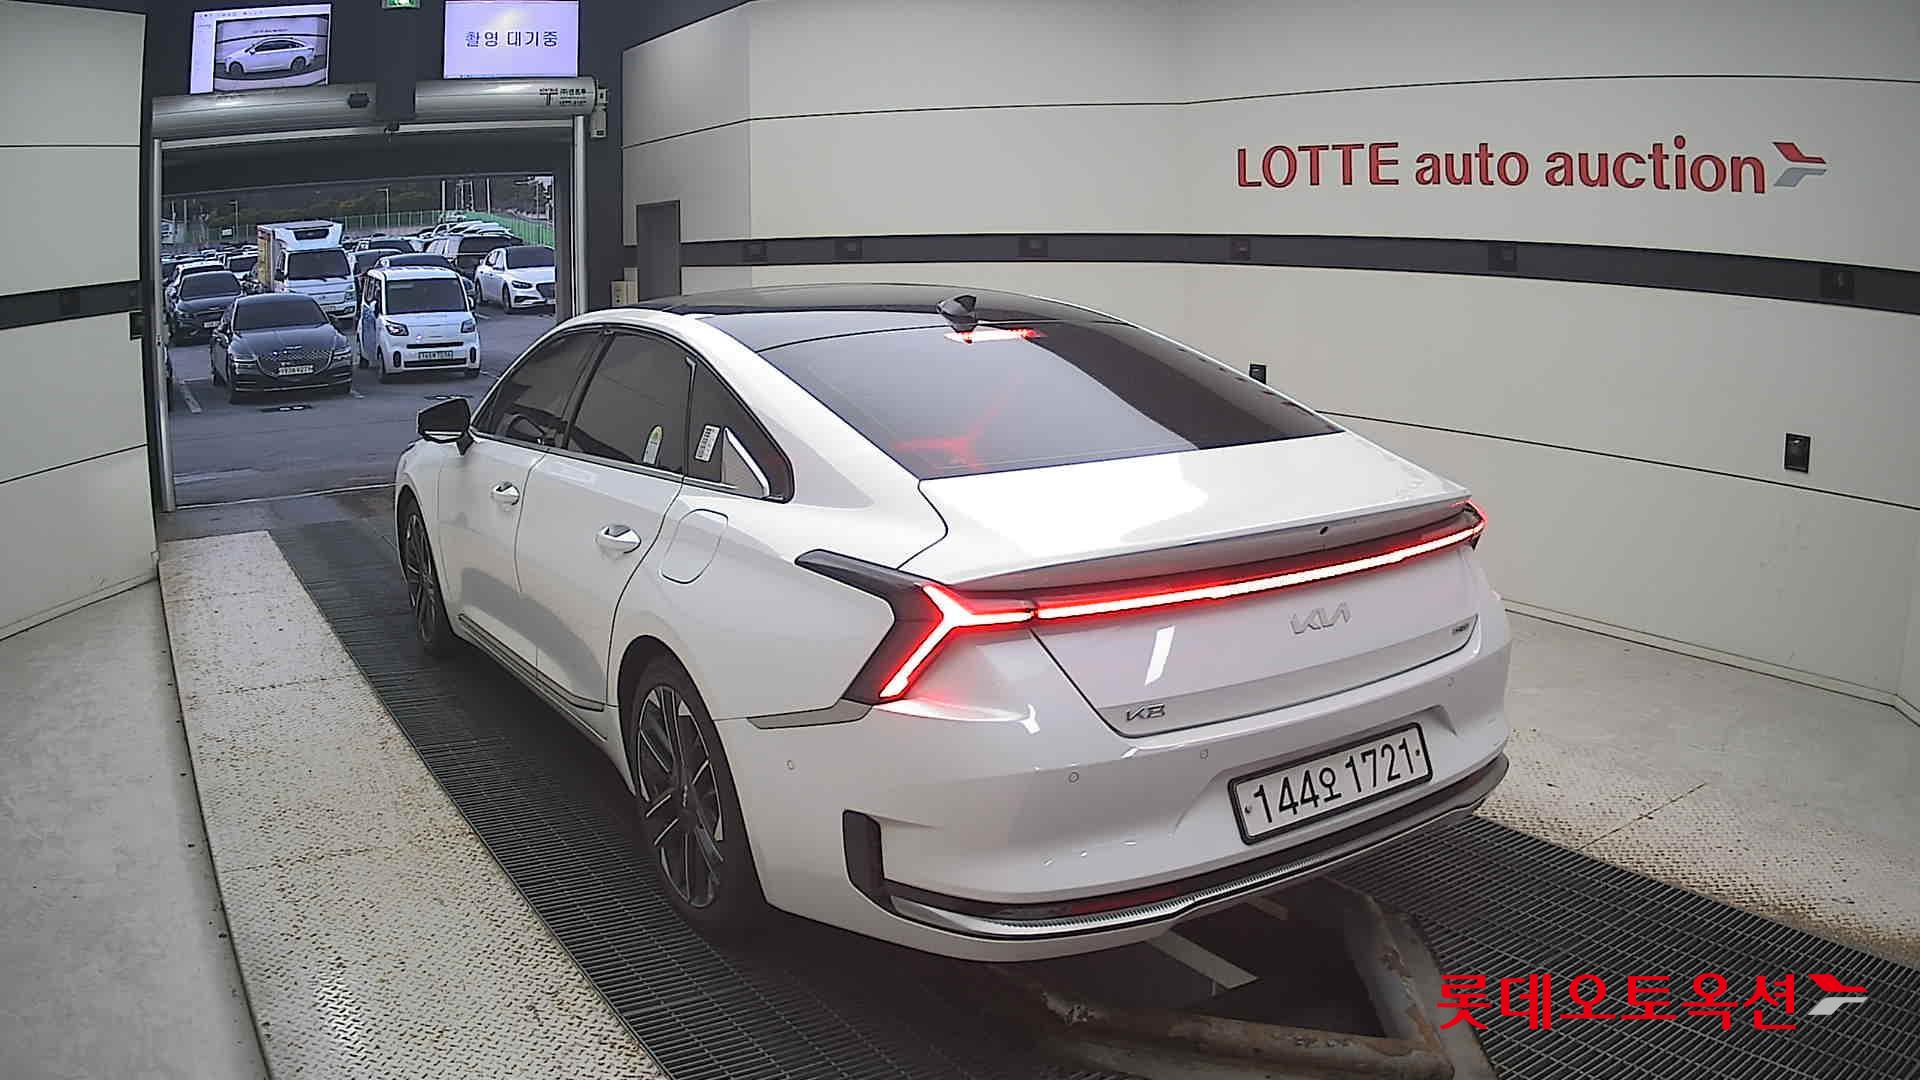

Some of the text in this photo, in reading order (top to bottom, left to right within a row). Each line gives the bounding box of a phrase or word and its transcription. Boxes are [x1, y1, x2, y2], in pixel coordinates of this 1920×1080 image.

[465, 31, 558, 47] 촬영 대기중
[1237, 135, 1767, 194] LOTTE auto auction
[1125, 703, 1166, 721] K8
[1345, 737, 1415, 793] 1721
